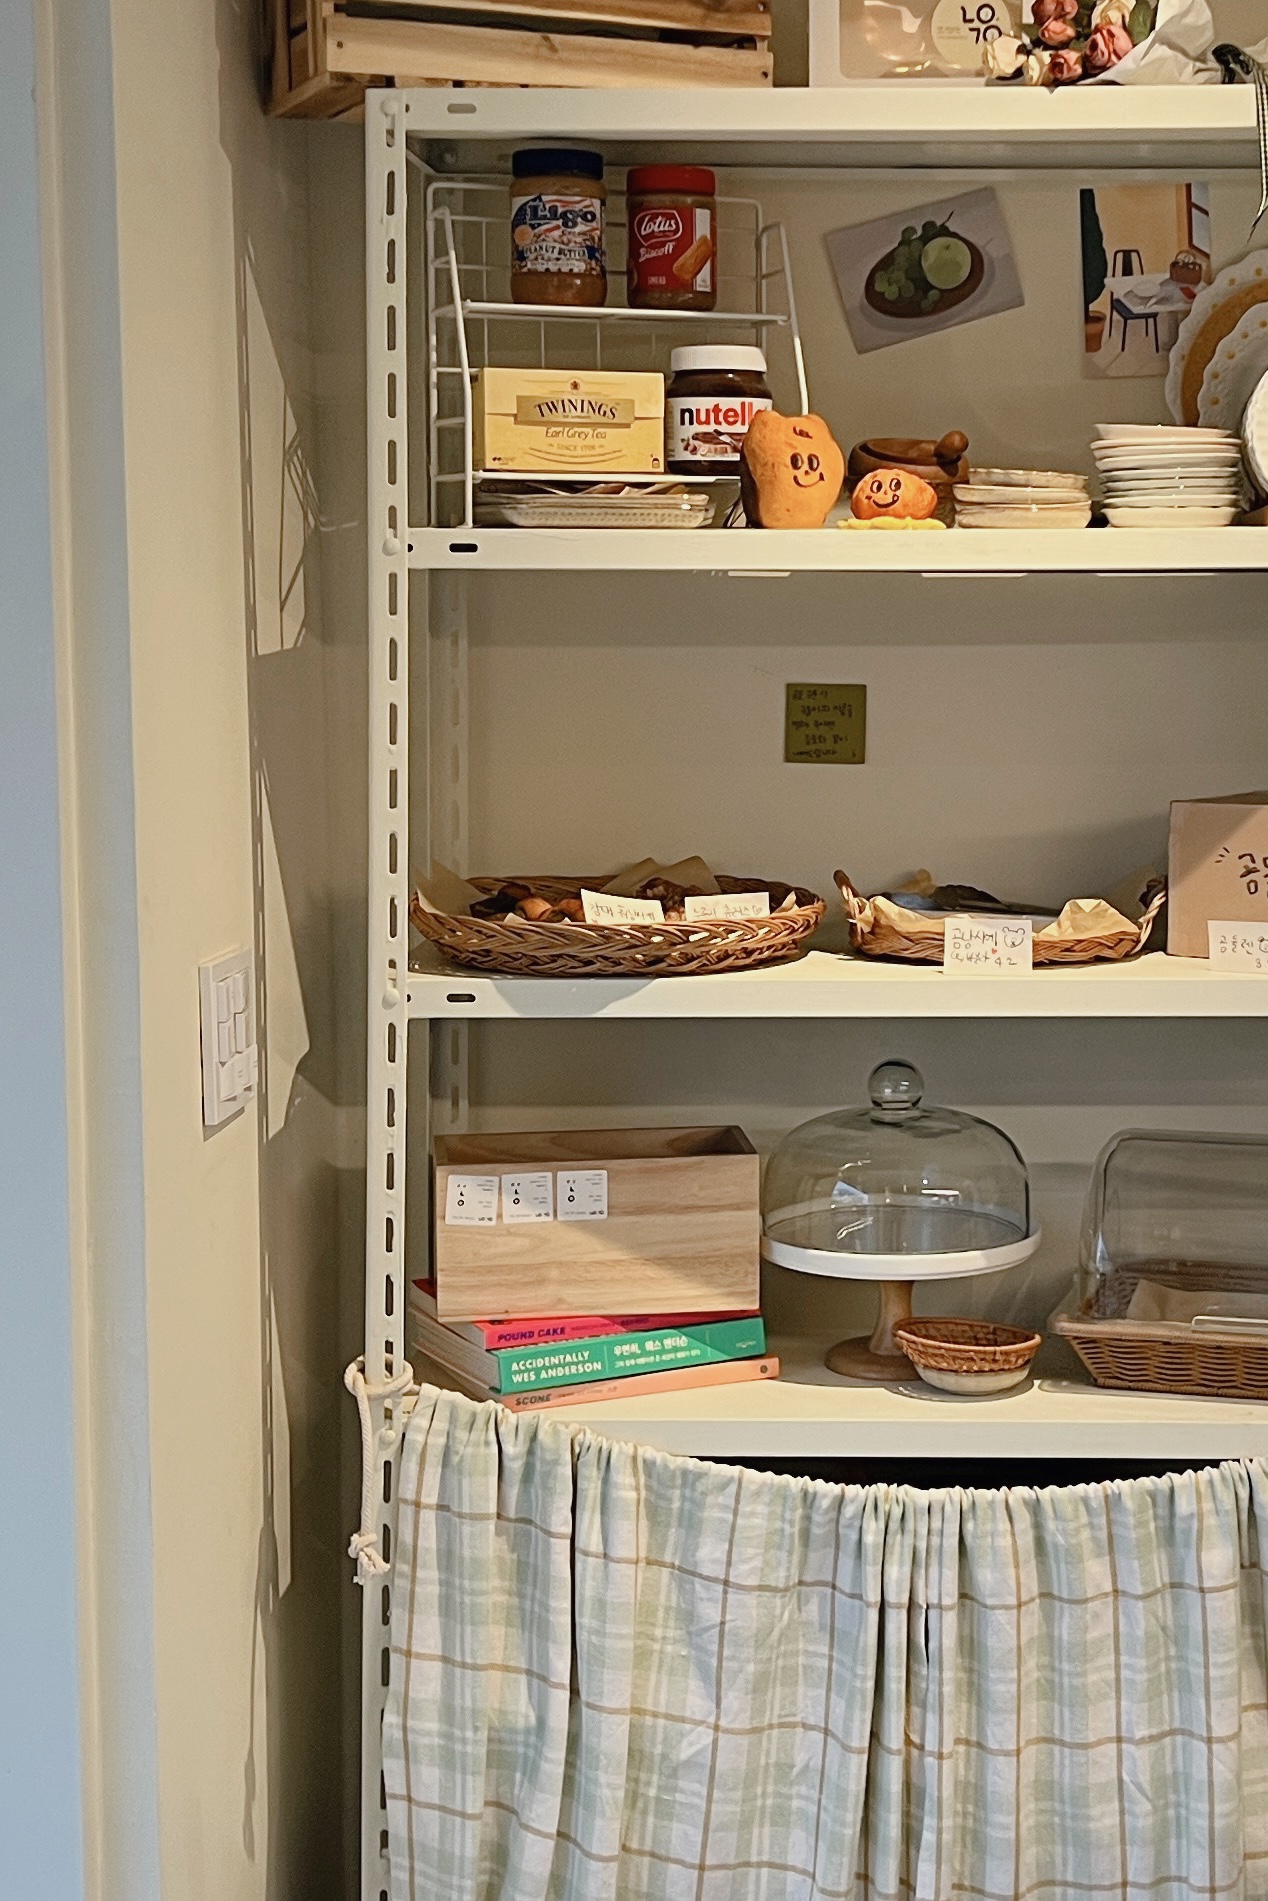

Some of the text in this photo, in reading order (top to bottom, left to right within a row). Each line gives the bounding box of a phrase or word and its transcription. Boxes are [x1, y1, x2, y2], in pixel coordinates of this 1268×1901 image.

[526, 203, 597, 229] Ligo
[640, 214, 677, 236] Lotus
[523, 243, 588, 258] PEANUT BUTTER
[638, 241, 676, 263] Biscoff
[534, 397, 618, 421] TWININGS
[680, 401, 755, 426] nutell
[545, 426, 607, 441] Earl Grey Tea
[497, 1326, 566, 1343] POUND CAKE
[511, 1350, 590, 1372] ACCIDENTALLY
[511, 1361, 602, 1384] WES ANDERSON
[514, 1393, 552, 1407] SCONE
